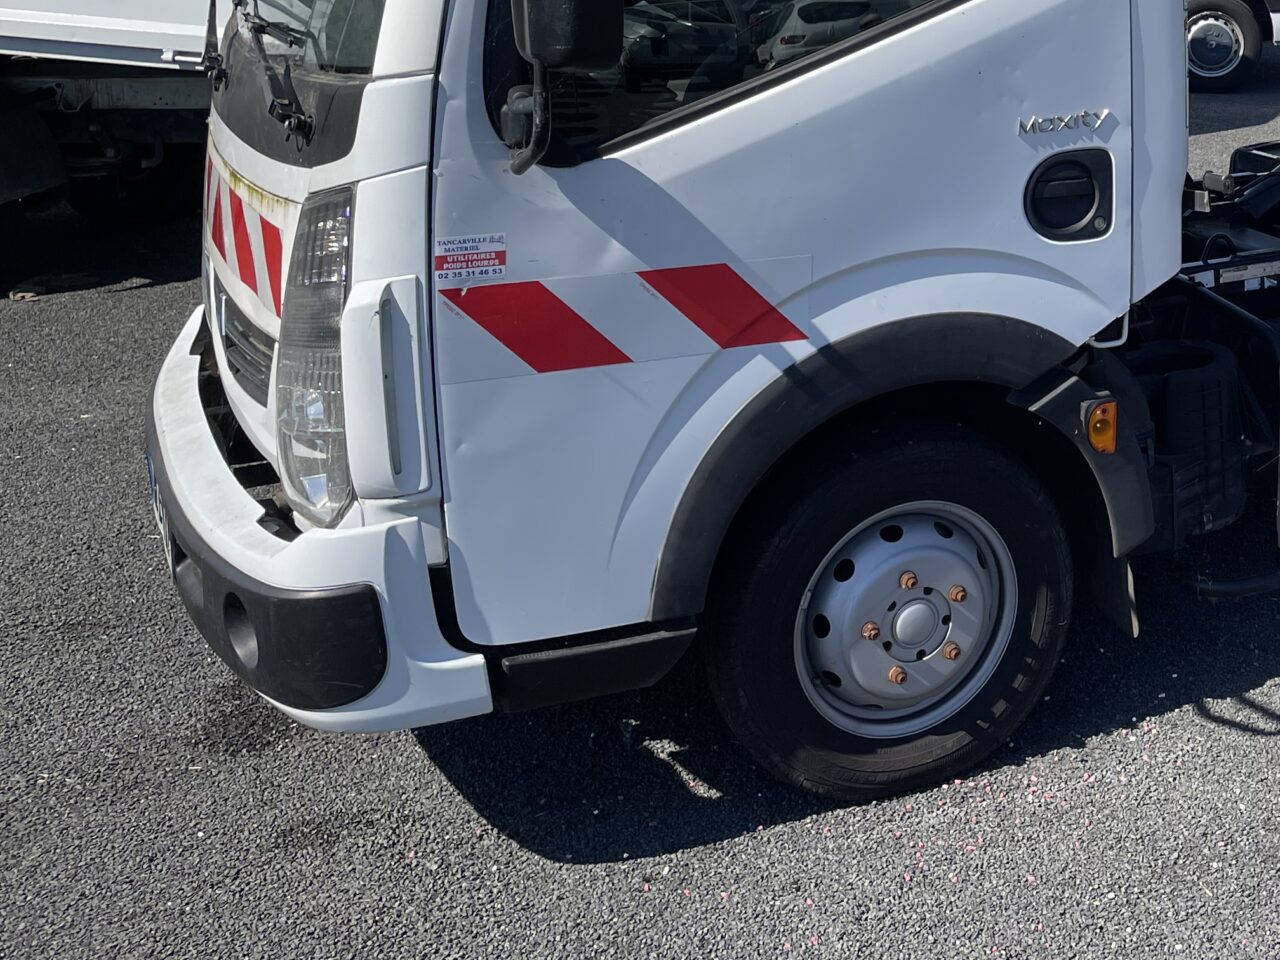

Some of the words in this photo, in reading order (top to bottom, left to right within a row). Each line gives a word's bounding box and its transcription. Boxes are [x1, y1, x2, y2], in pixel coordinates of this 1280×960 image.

[1016, 108, 1109, 136] Maxity
[437, 237, 487, 246] TANCARVILLE
[444, 245, 480, 253] MATERIEL
[447, 252, 495, 262] UTILITAIRES
[443, 261, 467, 269] POIDS
[468, 259, 499, 267] LOURDS
